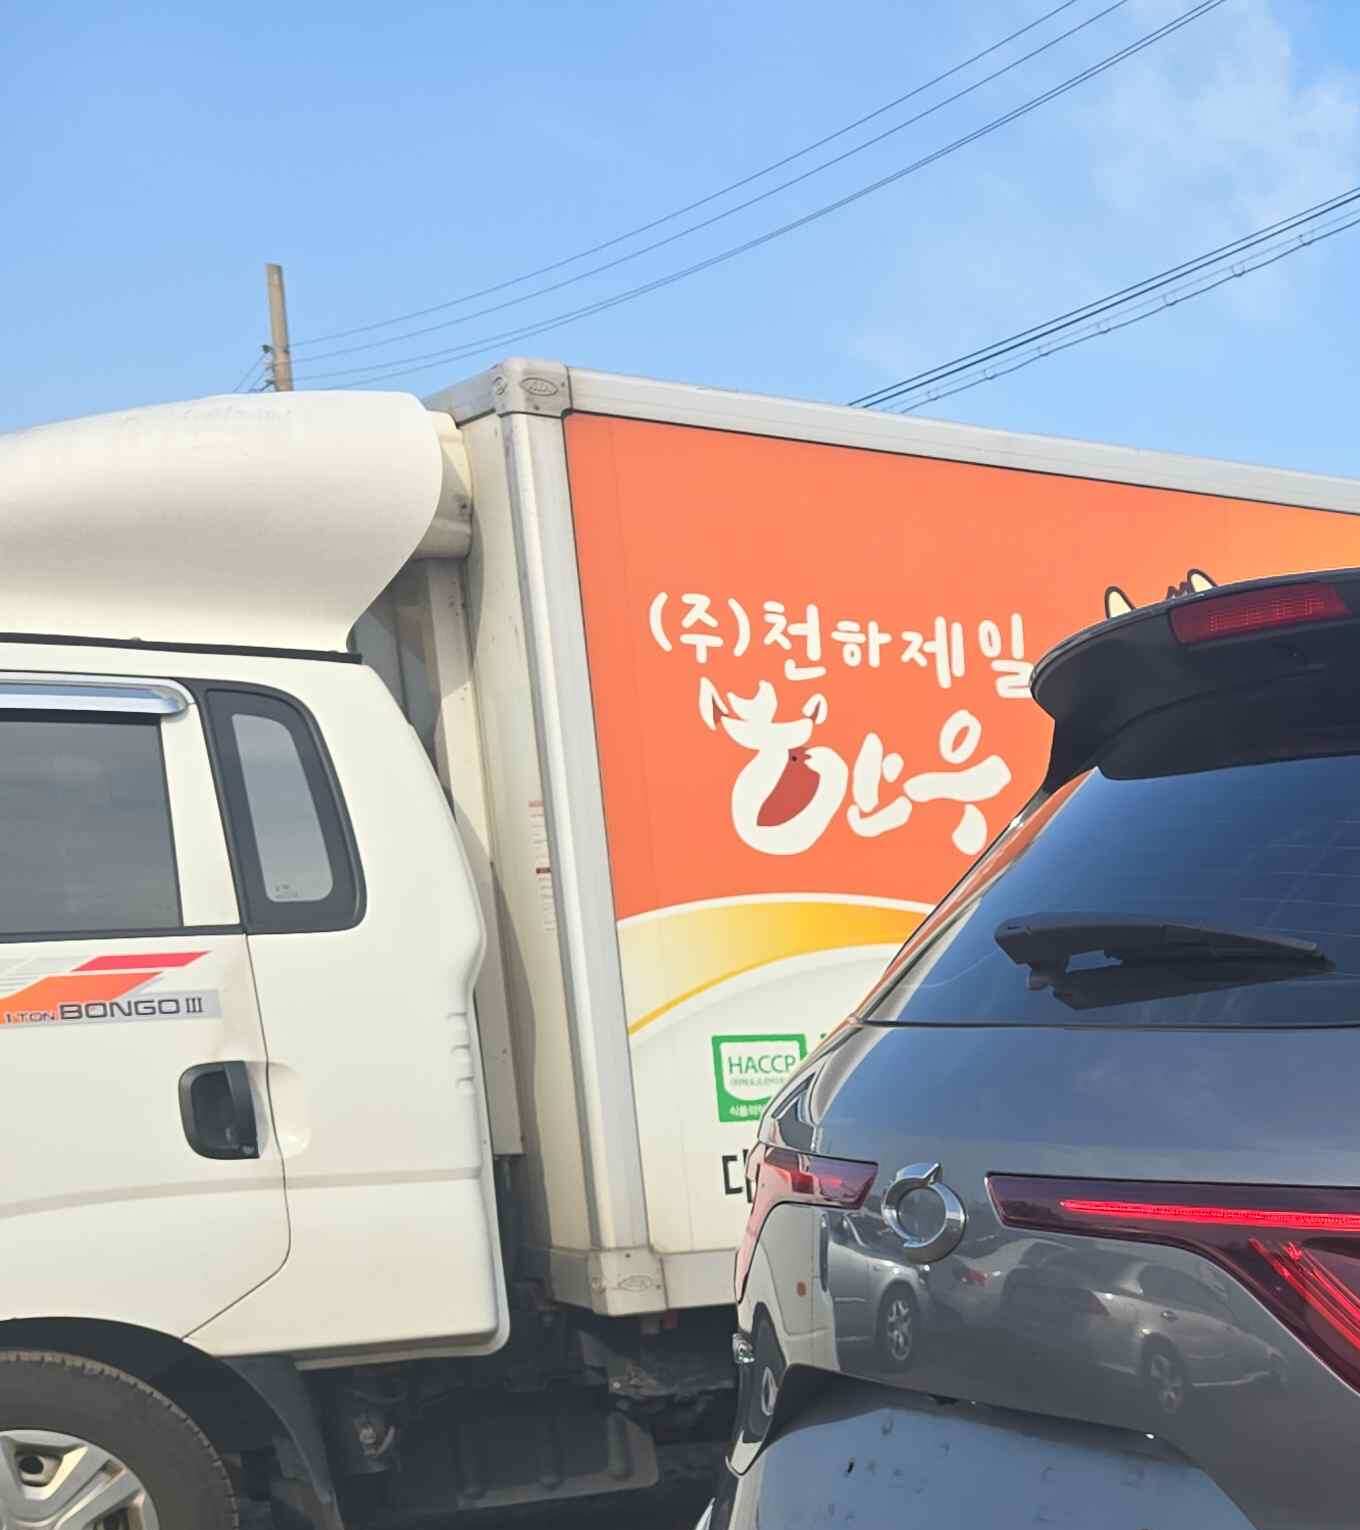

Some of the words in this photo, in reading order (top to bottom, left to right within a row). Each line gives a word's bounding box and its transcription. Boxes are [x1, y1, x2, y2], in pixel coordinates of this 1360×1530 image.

[648, 591, 1035, 699] (주)천하제일
[698, 676, 1013, 856] 한우
[59, 998, 180, 1020] BONGO
[185, 997, 204, 1013] III
[728, 1054, 796, 1074] HACCP
